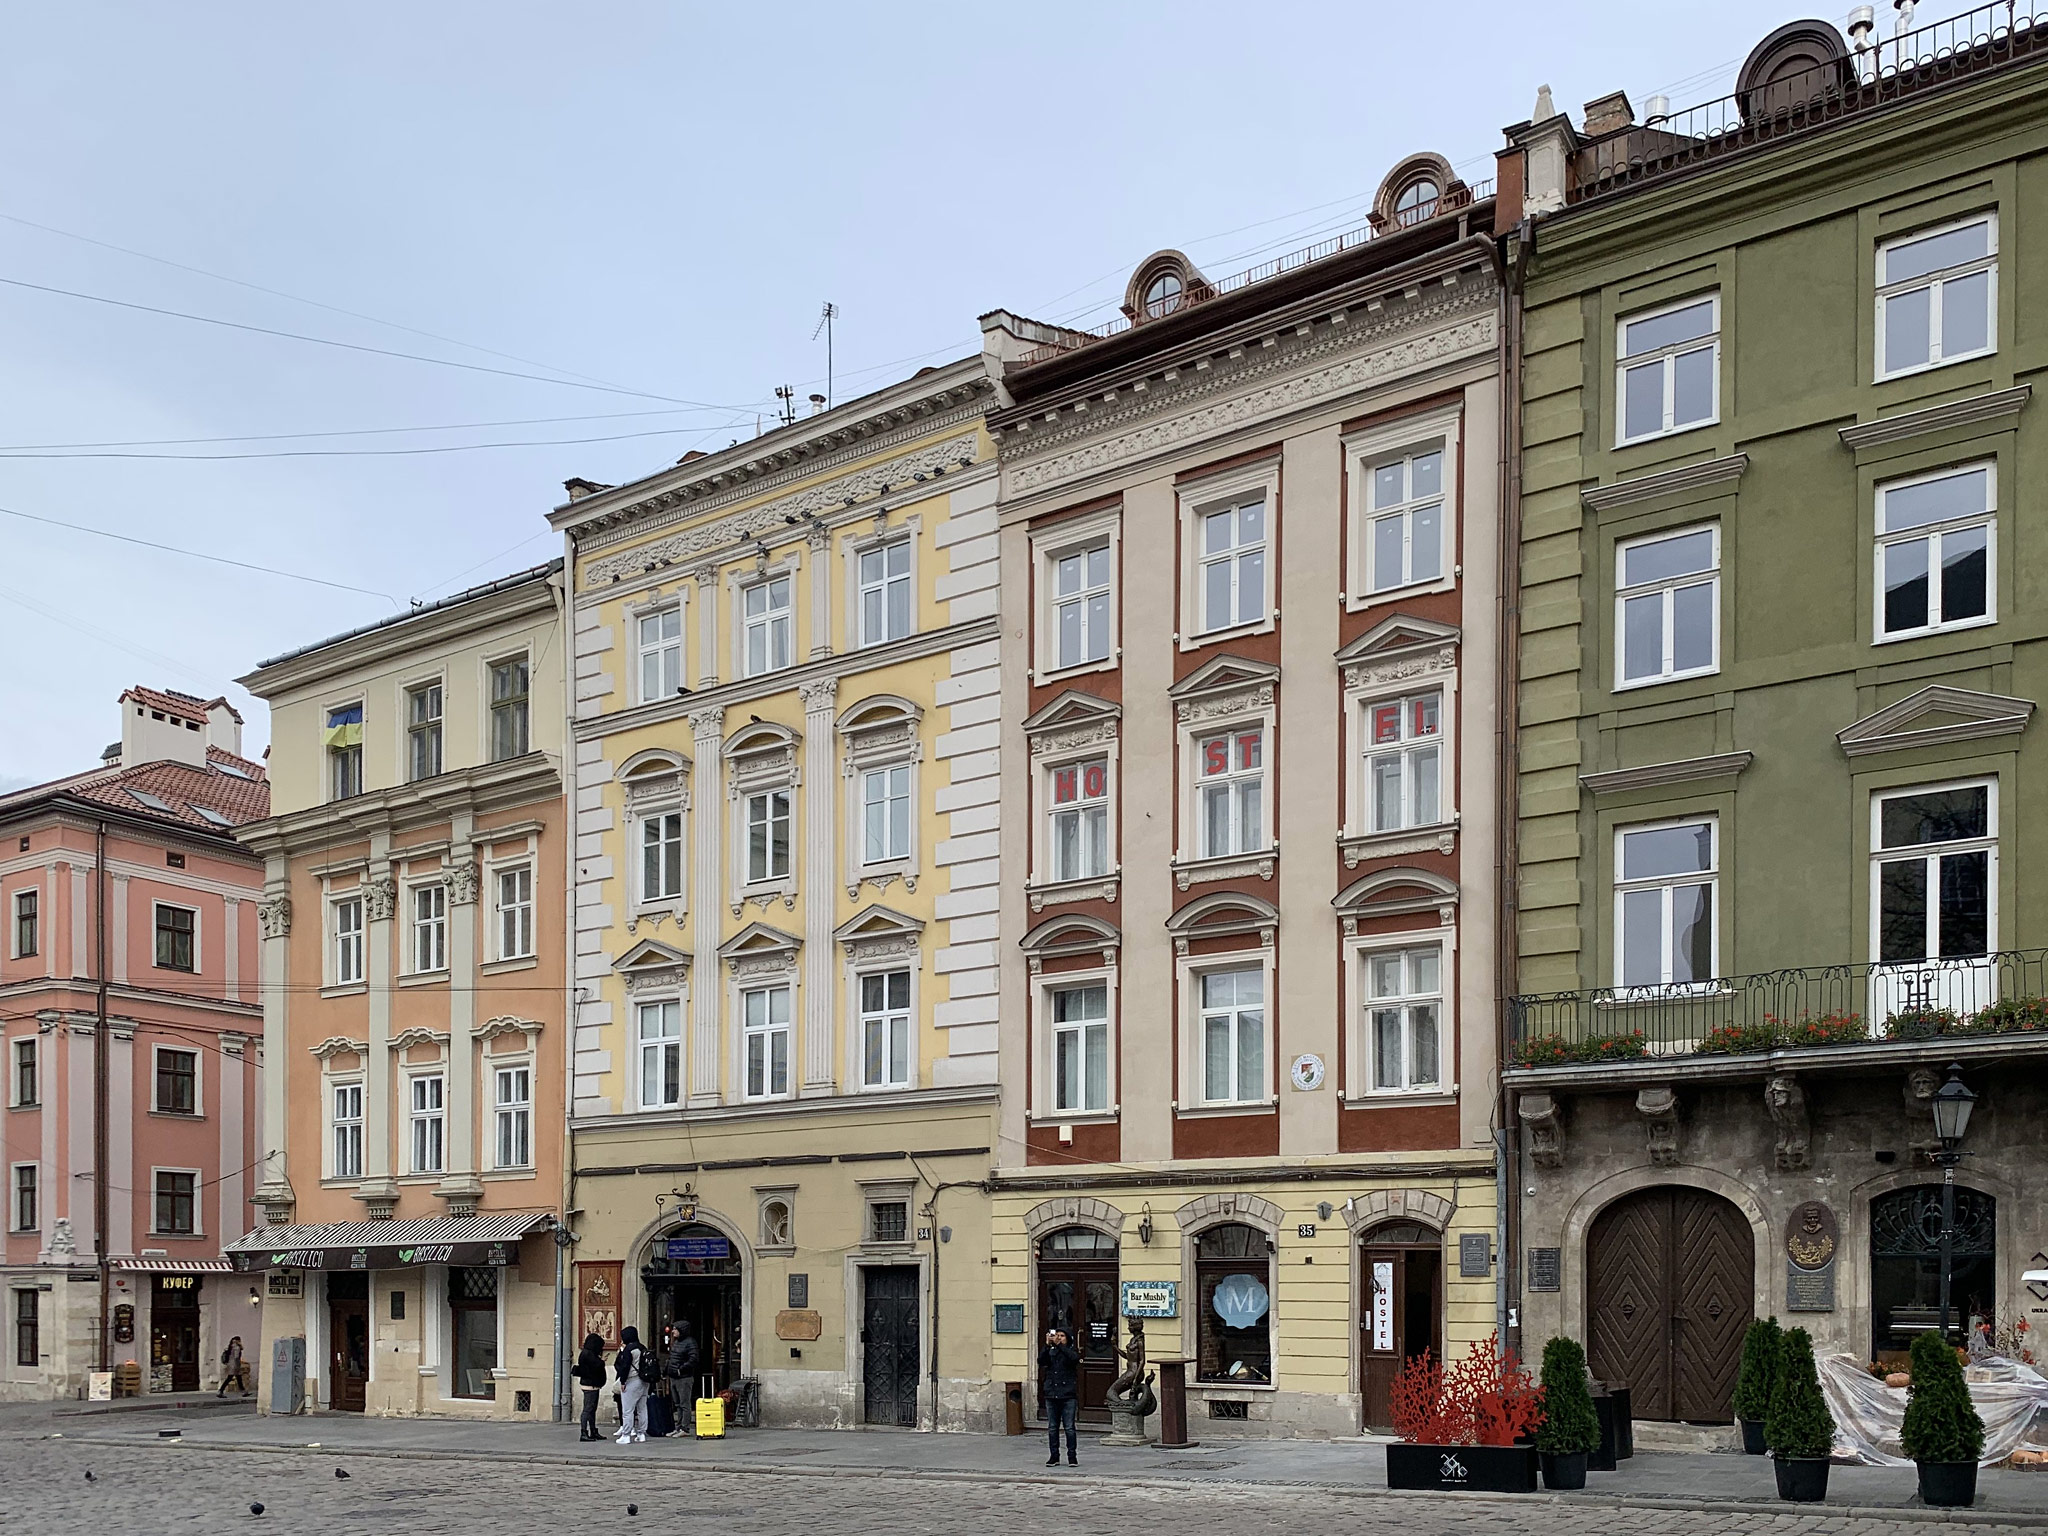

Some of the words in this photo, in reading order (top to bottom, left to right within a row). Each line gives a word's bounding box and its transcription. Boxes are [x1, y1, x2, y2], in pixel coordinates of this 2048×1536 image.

[918, 1228, 929, 1239] 34
[1300, 1225, 1313, 1237] 35
[282, 1250, 324, 1268] BASILICO
[412, 1245, 454, 1263] BASILICO
[162, 1277, 194, 1289] КУФЕР
[1130, 1292, 1142, 1301] Bar
[1142, 1292, 1167, 1304] Mushly
[1225, 1284, 1257, 1315] M
[1379, 1287, 1387, 1349] HOSTEL
